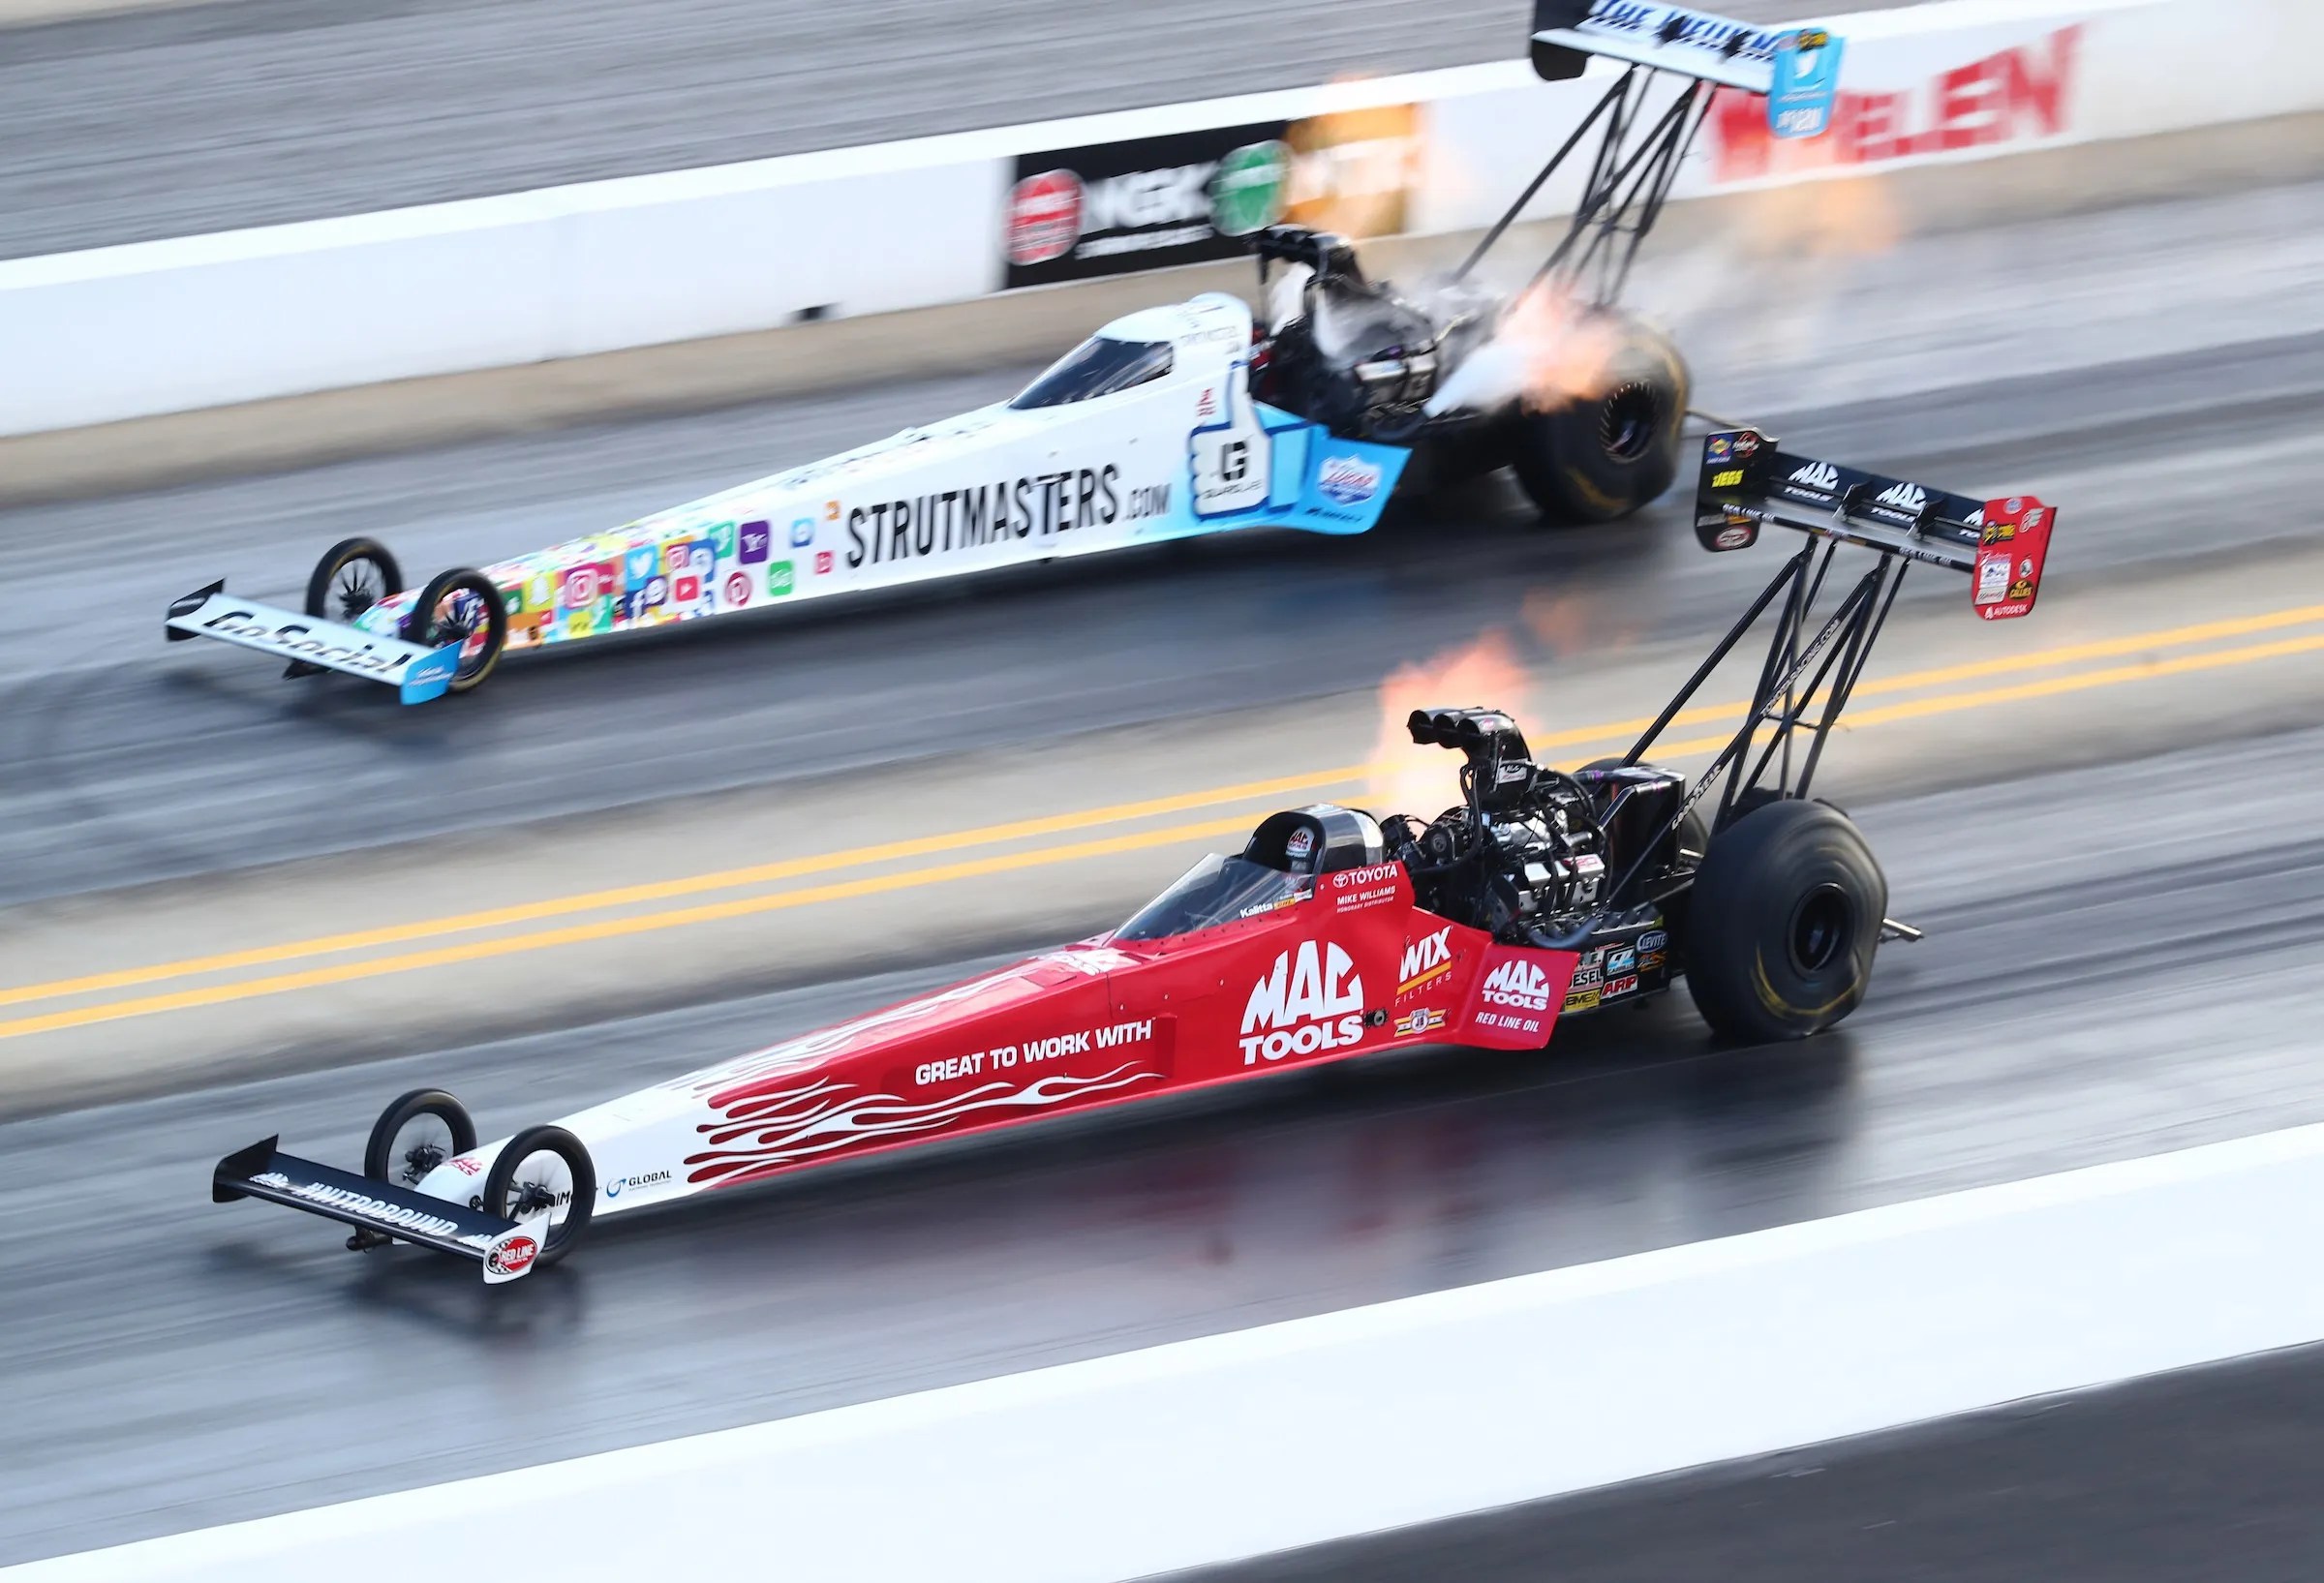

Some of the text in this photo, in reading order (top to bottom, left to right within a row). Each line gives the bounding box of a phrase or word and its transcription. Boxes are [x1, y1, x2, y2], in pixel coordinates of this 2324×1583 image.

[1711, 470, 1744, 488] JEGS
[1789, 462, 1839, 491] MAC
[1784, 485, 1834, 502] TOOLS
[1876, 482, 1927, 510] MAC
[1993, 604, 2028, 616] AUTODESK
[1348, 864, 1397, 886] TOYOTA
[1336, 885, 1396, 905] MIKE WILLIAMS
[1239, 902, 1273, 918] Kalitta
[1398, 925, 1452, 984] WIX
[1240, 939, 1363, 1035] MAC
[1394, 970, 1452, 1007] FILTERS
[1483, 959, 1549, 998] MAC
[1602, 976, 1636, 996] ARP
[1482, 989, 1547, 1011] TOOLS
[1476, 1011, 1540, 1033] RED LINE OIL
[1238, 1014, 1363, 1066] TOOLS
[914, 1019, 1153, 1085] GREAT TO WORK WITH
[628, 1170, 672, 1186] GLOBAL
[516, 1244, 534, 1259] LINE
